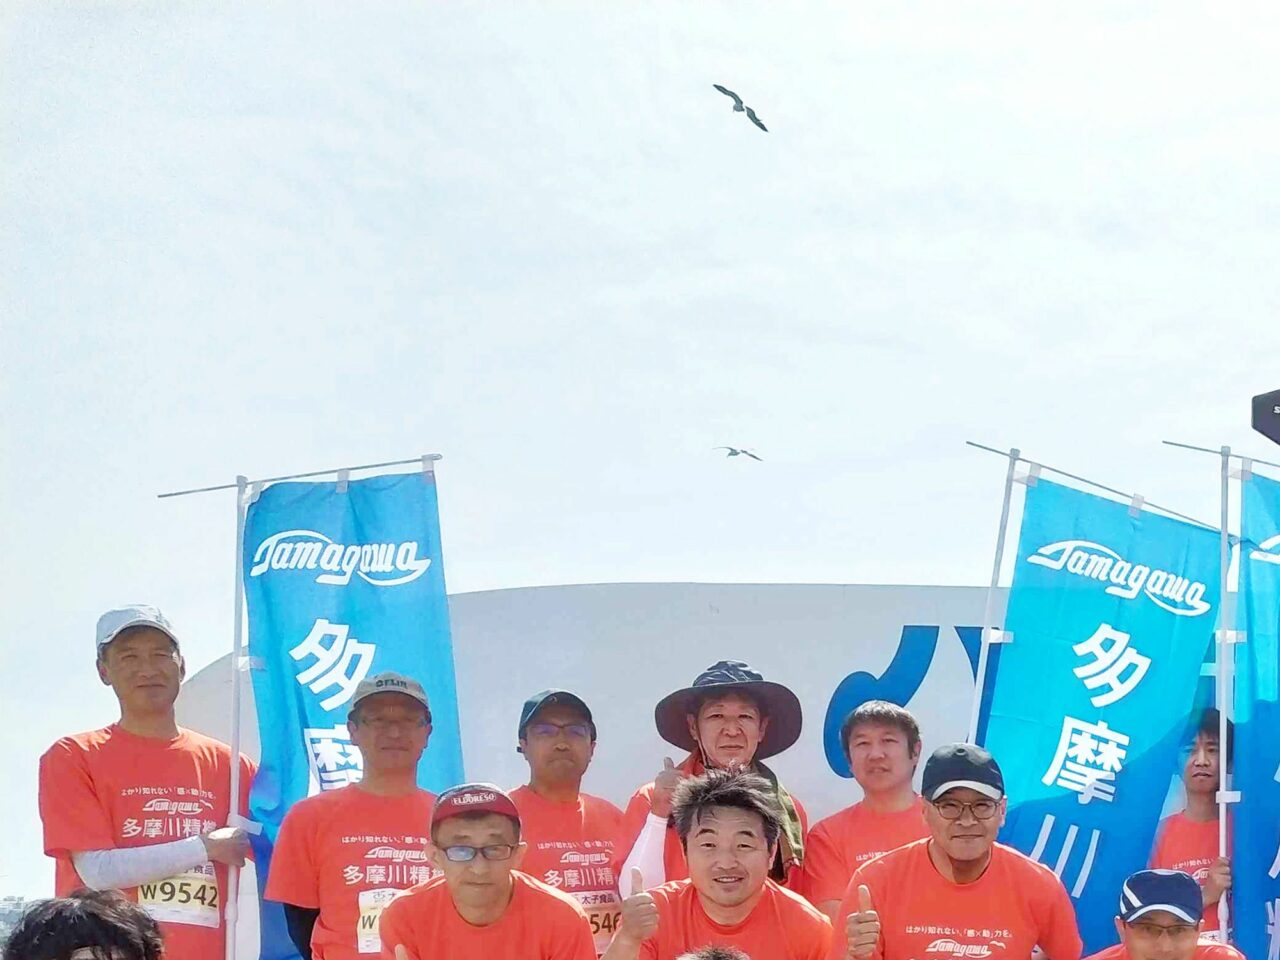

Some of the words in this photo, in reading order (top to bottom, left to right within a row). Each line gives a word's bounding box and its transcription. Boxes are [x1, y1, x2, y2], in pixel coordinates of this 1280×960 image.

[250, 529, 432, 587] Tamagawa
[1026, 539, 1212, 617] Tamagawa
[140, 882, 218, 908] W9542
[925, 938, 993, 959] Tamagawa
